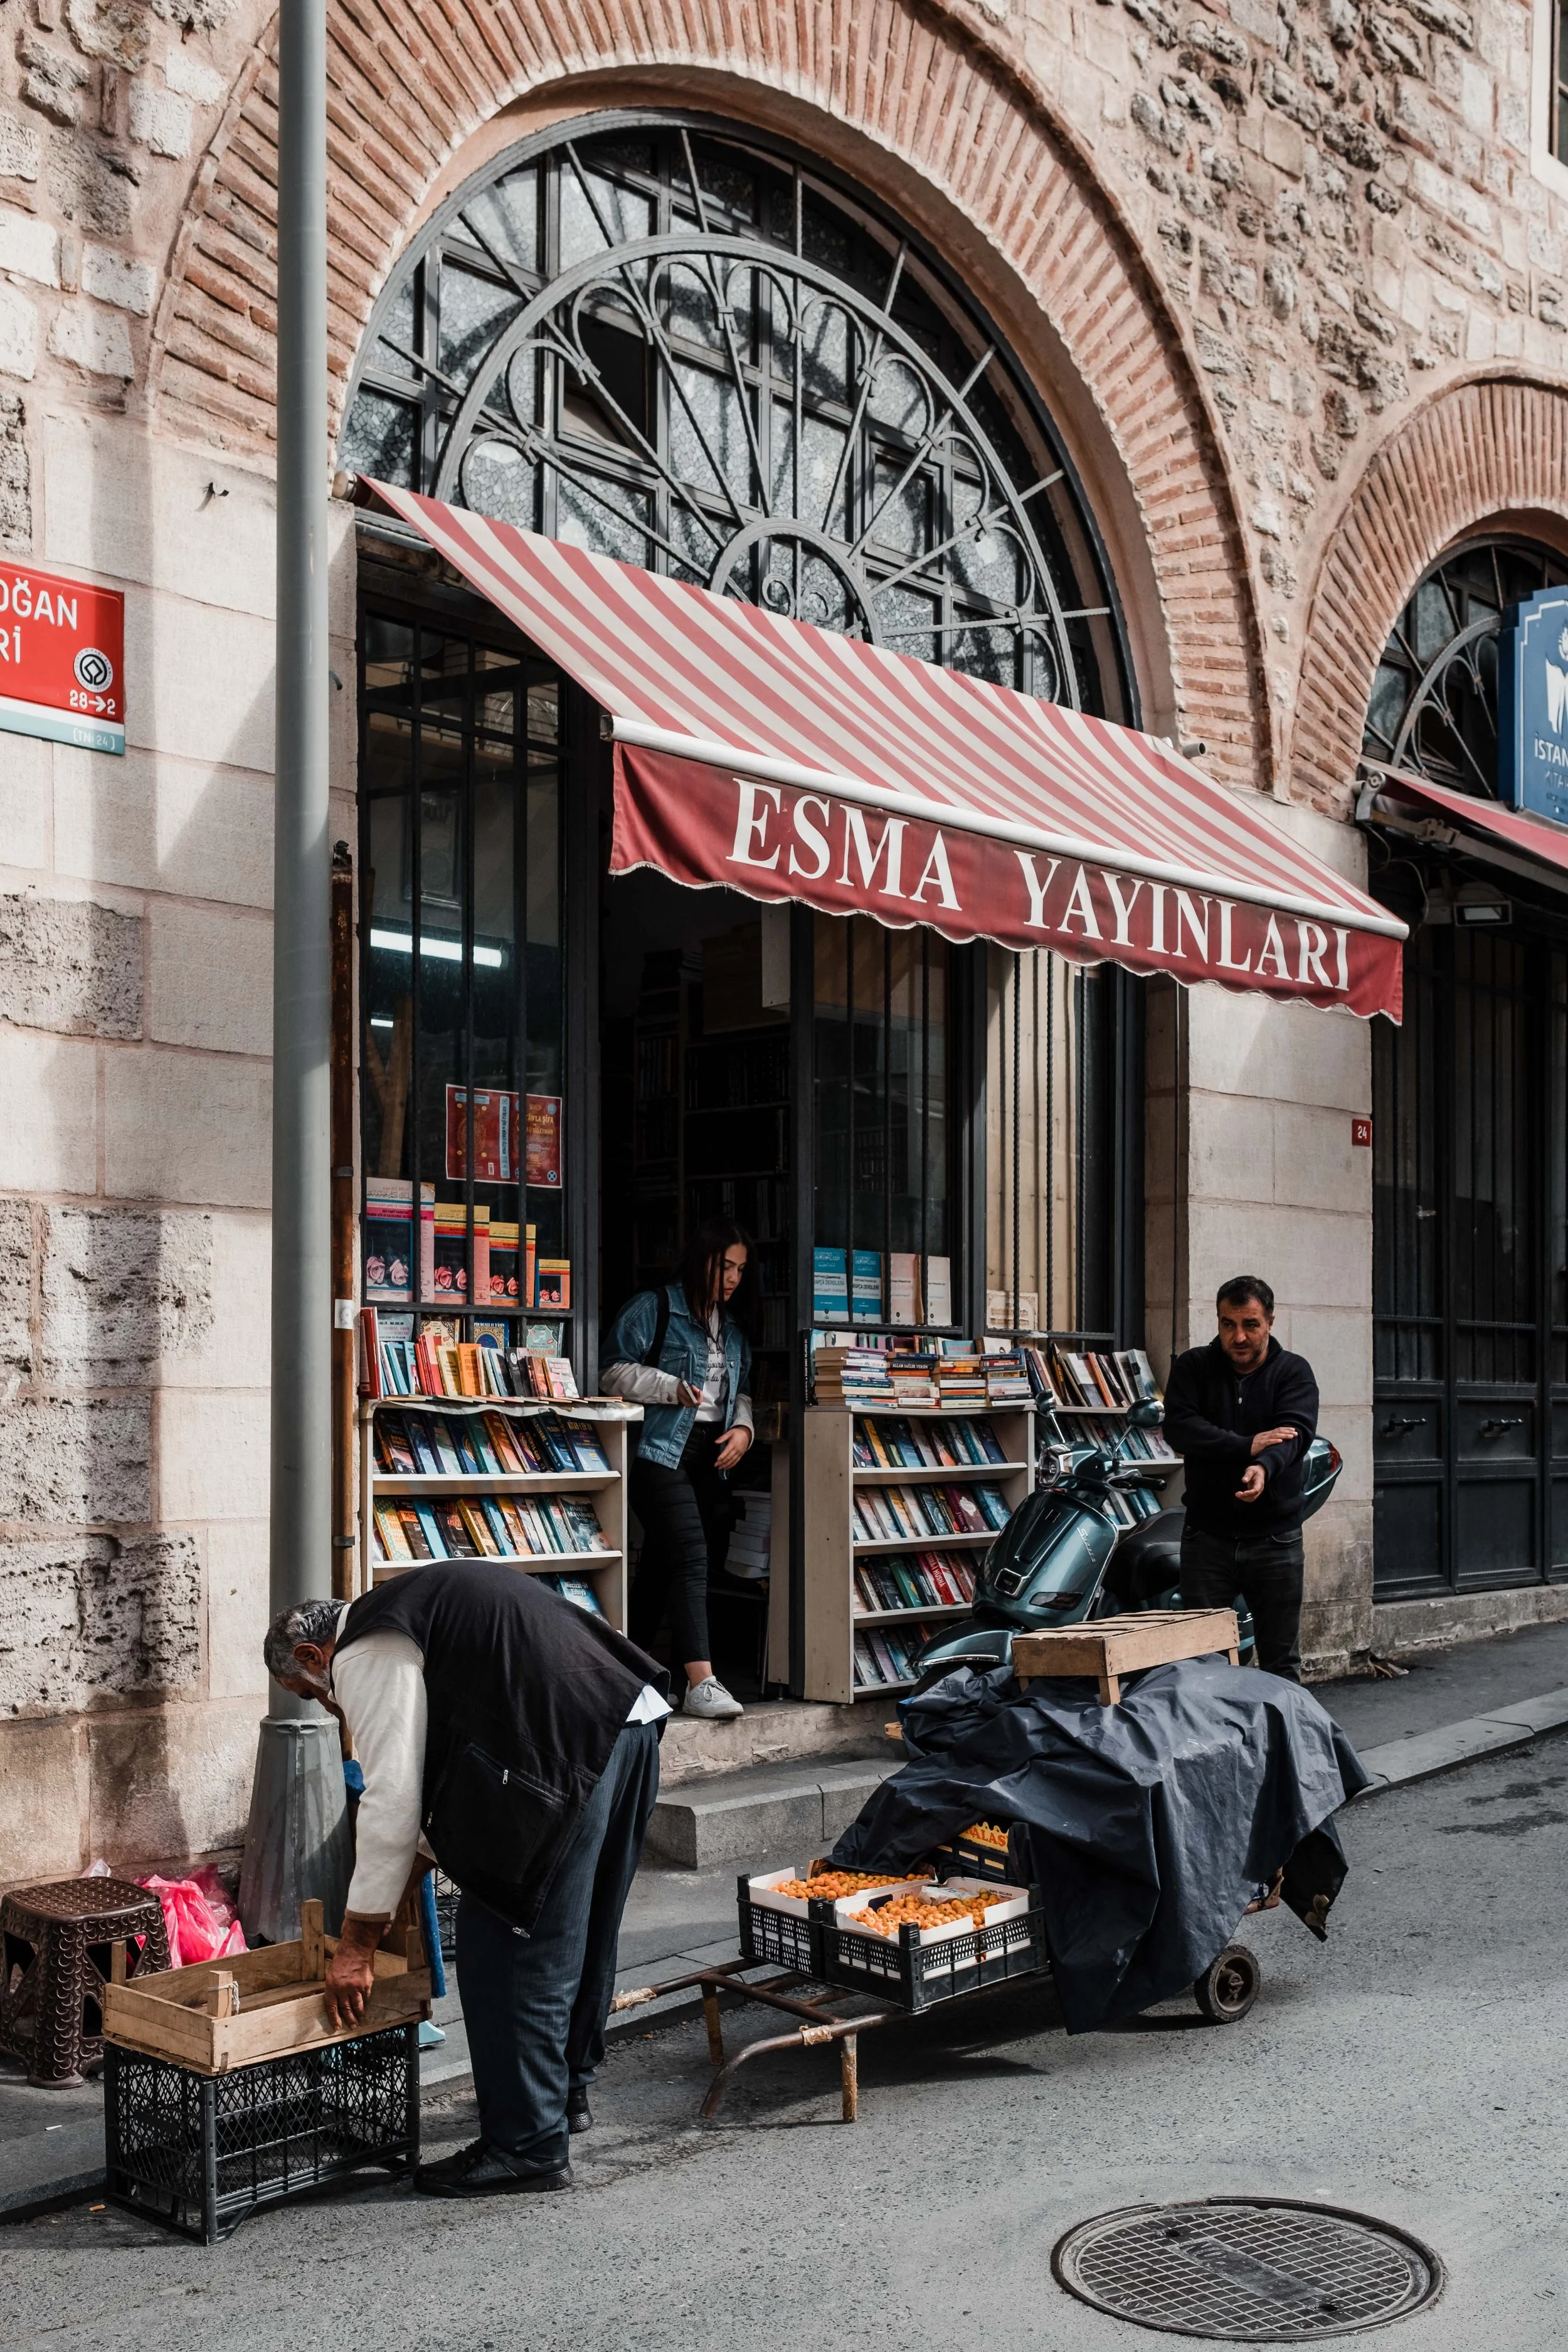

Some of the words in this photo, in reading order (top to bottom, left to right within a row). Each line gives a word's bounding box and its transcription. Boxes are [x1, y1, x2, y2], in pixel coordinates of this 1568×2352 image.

[70, 689, 88, 709] 28
[96, 734, 108, 747] 24
[726, 778, 962, 911] ESMA
[1014, 850, 1351, 992] YAYINLARI
[1357, 1125, 1367, 1140] 24
